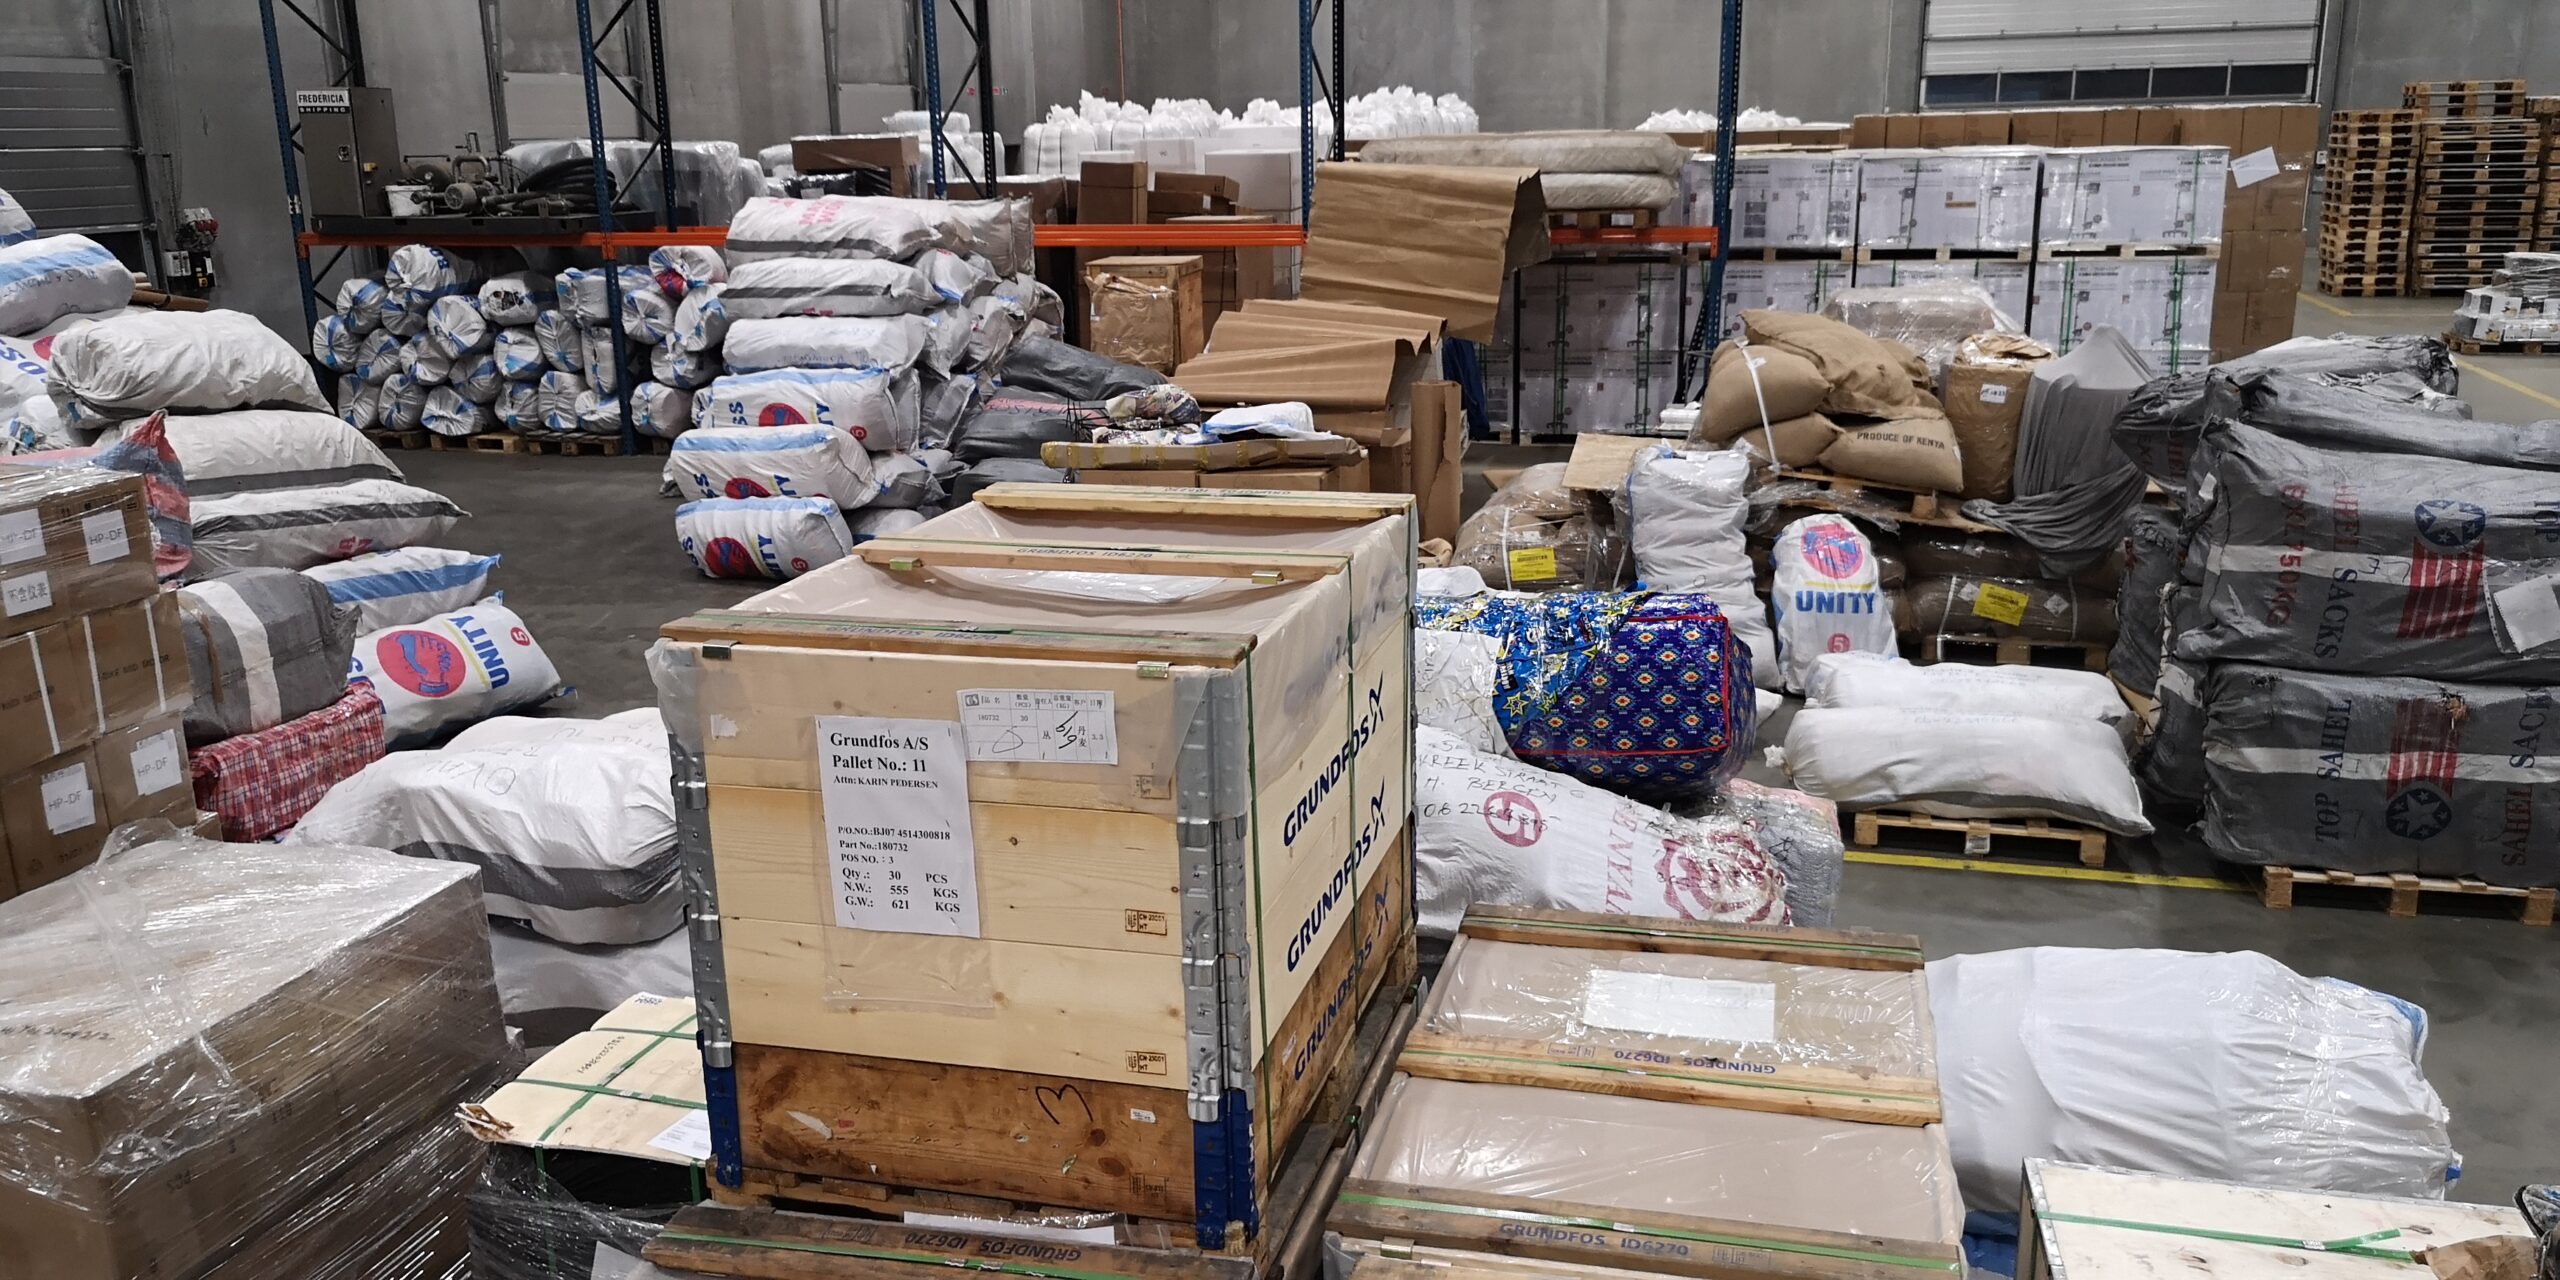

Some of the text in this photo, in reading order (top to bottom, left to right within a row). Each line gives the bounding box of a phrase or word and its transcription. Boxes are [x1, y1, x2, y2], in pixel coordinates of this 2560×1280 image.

[298, 94, 345, 103] FREDERICIA
[1857, 432, 1945, 449] PRODUCE OF KENYA
[89, 527, 123, 545] HP-DF
[1016, 547, 1096, 557] GRUNDFOS
[1795, 590, 1876, 614] UNITY
[2313, 567, 2358, 659] SACKS
[447, 615, 510, 690] UNITY
[830, 732, 929, 751] Grundfos A/S
[137, 757, 170, 776] HP-DF
[832, 754, 926, 772] Pallet No.: 11
[2314, 698, 2352, 843] TOP SAHEL
[833, 775, 939, 789] Attn: KARIN PEDERSEN
[1283, 714, 1370, 847] GRUNDFOS
[48, 790, 82, 811] HP-DF
[897, 829, 951, 840] 4514300818
[2501, 784, 2533, 867] SAHEL
[839, 840, 908, 852] Part No.:180732
[840, 853, 859, 863] POS
[888, 856, 894, 864] 3
[842, 867, 861, 880] Qty
[888, 870, 901, 880] 30
[925, 873, 948, 884] PCS
[844, 881, 959, 899] N.W.: 555 KGS
[1287, 822, 1372, 973] GRUNDFOS
[845, 895, 960, 913] G.W.: 621 KGS
[1294, 932, 1373, 1081] GRUNDFOS
[1613, 1049, 1671, 1065] ID6270
[1682, 1057, 1776, 1075] GRUNDFOS
[904, 1231, 968, 1251] ID6270
[1498, 1222, 1606, 1247] GRUNDFOS
[1620, 1237, 1690, 1257] ID6270
[978, 1239, 1082, 1262] GRUNDFOS
